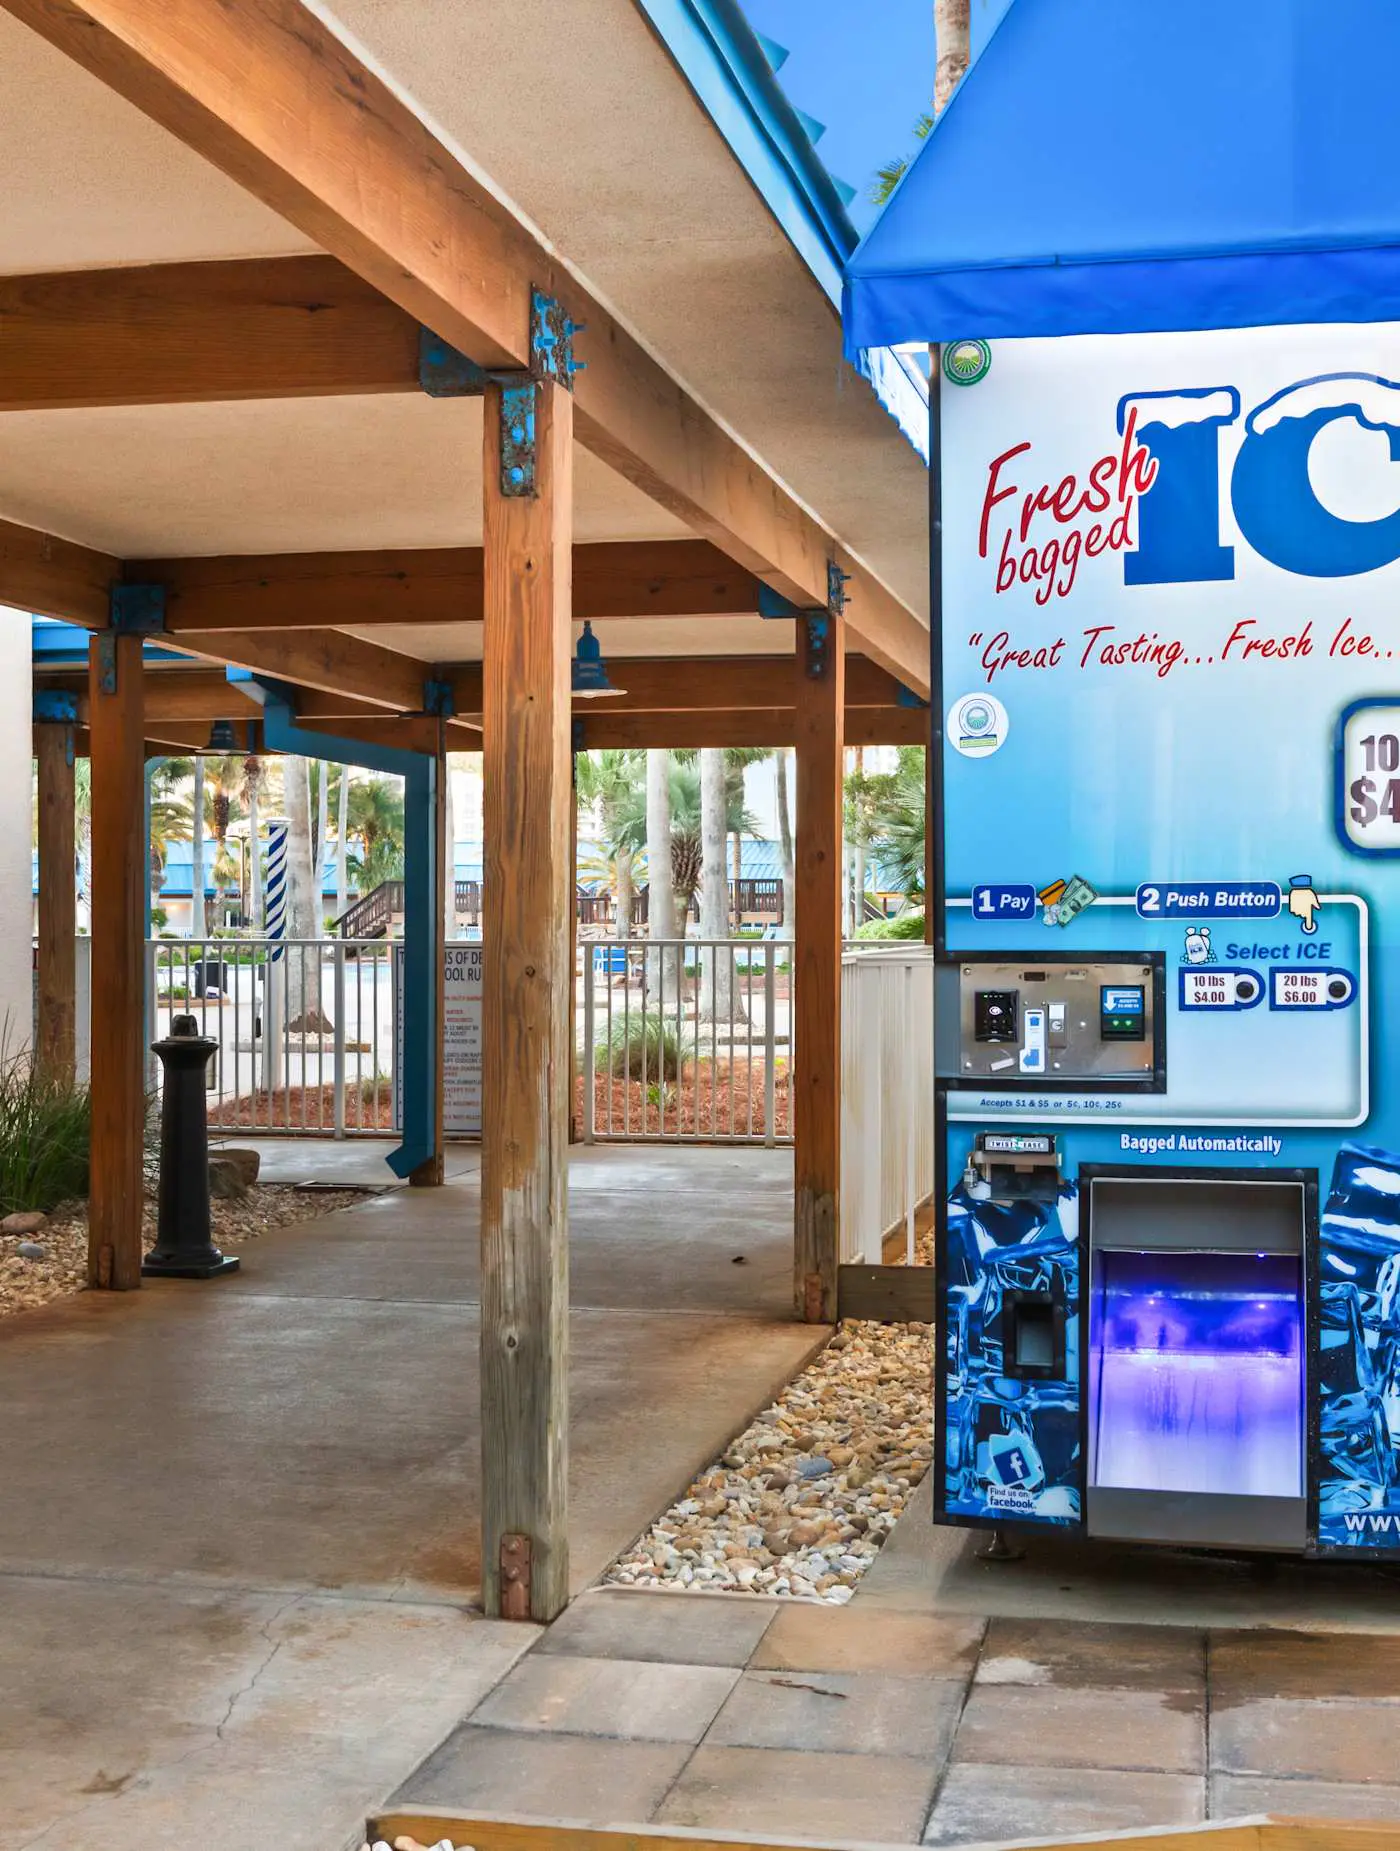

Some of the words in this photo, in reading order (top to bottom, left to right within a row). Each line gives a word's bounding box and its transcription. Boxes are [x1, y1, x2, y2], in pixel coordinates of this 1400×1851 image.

[979, 407, 1158, 558] Fresh
[1117, 371, 1400, 586] IC
[996, 496, 1134, 606] bagged
[1359, 733, 1400, 772] 10
[1350, 775, 1400, 828] $4
[977, 889, 996, 913] 1
[1000, 893, 1031, 912] Pay
[1141, 888, 1161, 911] 2
[1166, 890, 1209, 908] Push
[1214, 889, 1277, 907] Button
[455, 951, 469, 965] OF
[1225, 942, 1291, 960] Select
[1296, 942, 1332, 960] ICE
[1193, 975, 1205, 987] 10
[1208, 975, 1226, 987] lbs
[1283, 975, 1298, 987] 20
[1300, 975, 1318, 987] lbs
[1194, 990, 1226, 1003] $4.00
[1284, 990, 1317, 1003] $6.00
[980, 1098, 1012, 1109] Accepts
[1120, 1134, 1175, 1154] Bagged
[1178, 1135, 1282, 1156] Automatically
[990, 1487, 1006, 1496] Find
[1008, 1489, 1017, 1497] us
